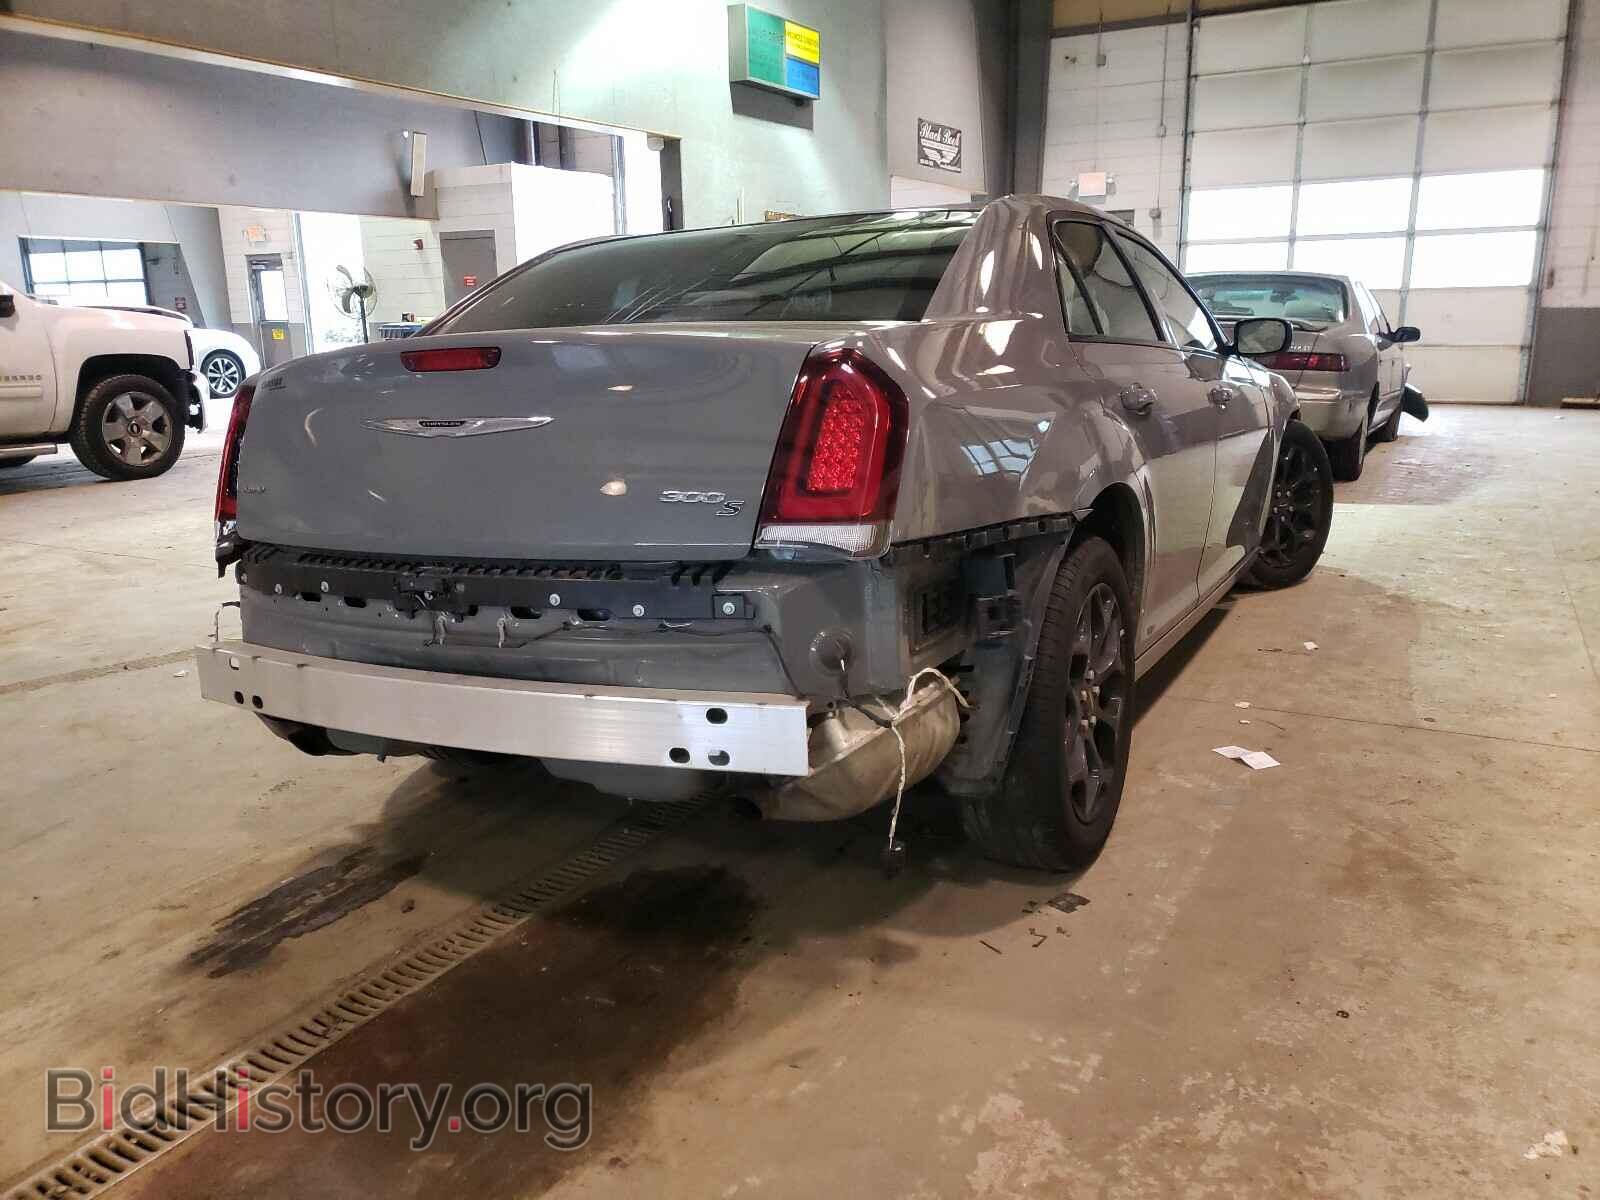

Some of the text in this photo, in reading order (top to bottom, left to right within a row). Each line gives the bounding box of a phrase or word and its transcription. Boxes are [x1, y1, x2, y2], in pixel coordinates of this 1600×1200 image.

[920, 122, 942, 141] Black
[658, 490, 745, 516] 300 S
